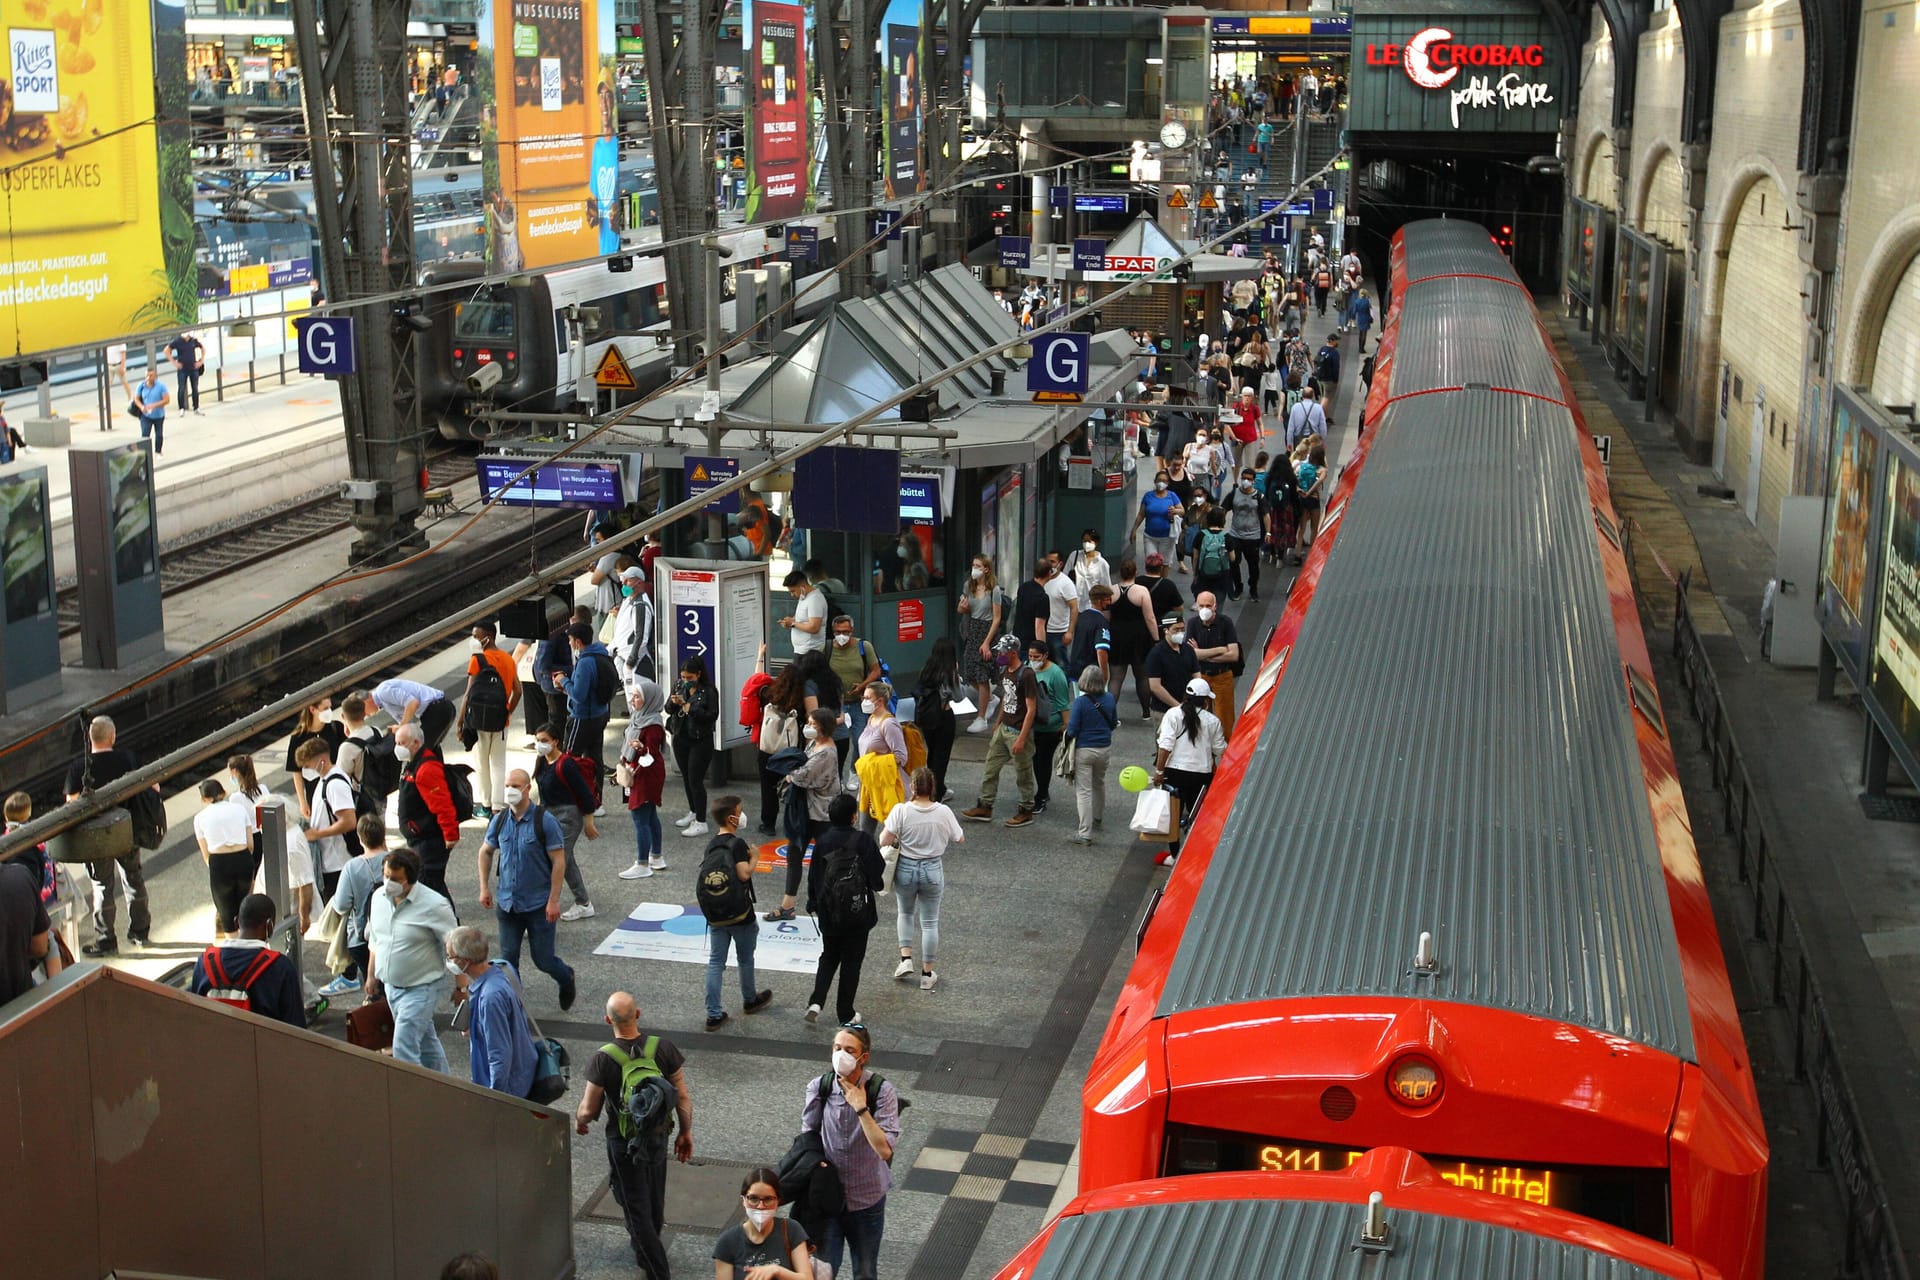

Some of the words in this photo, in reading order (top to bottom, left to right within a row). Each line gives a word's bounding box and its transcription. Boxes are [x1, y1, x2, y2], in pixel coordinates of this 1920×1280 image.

[515, 3, 580, 20] NUSSKLASSE
[13, 41, 53, 74] Ritter
[1366, 44, 1399, 65] LE
[16, 75, 54, 93] SPORT
[90, 252, 108, 267] GUT.
[1003, 251, 1026, 259] Kurzzug
[1078, 254, 1101, 262] Kurzzug
[1104, 259, 1154, 270] SPAR
[306, 321, 337, 365] G
[1045, 338, 1079, 383] G
[571, 475, 599, 484] Neugraben
[601, 476, 606, 484] 2
[683, 609, 700, 636] 3
[1260, 1146, 1320, 1171] S11
